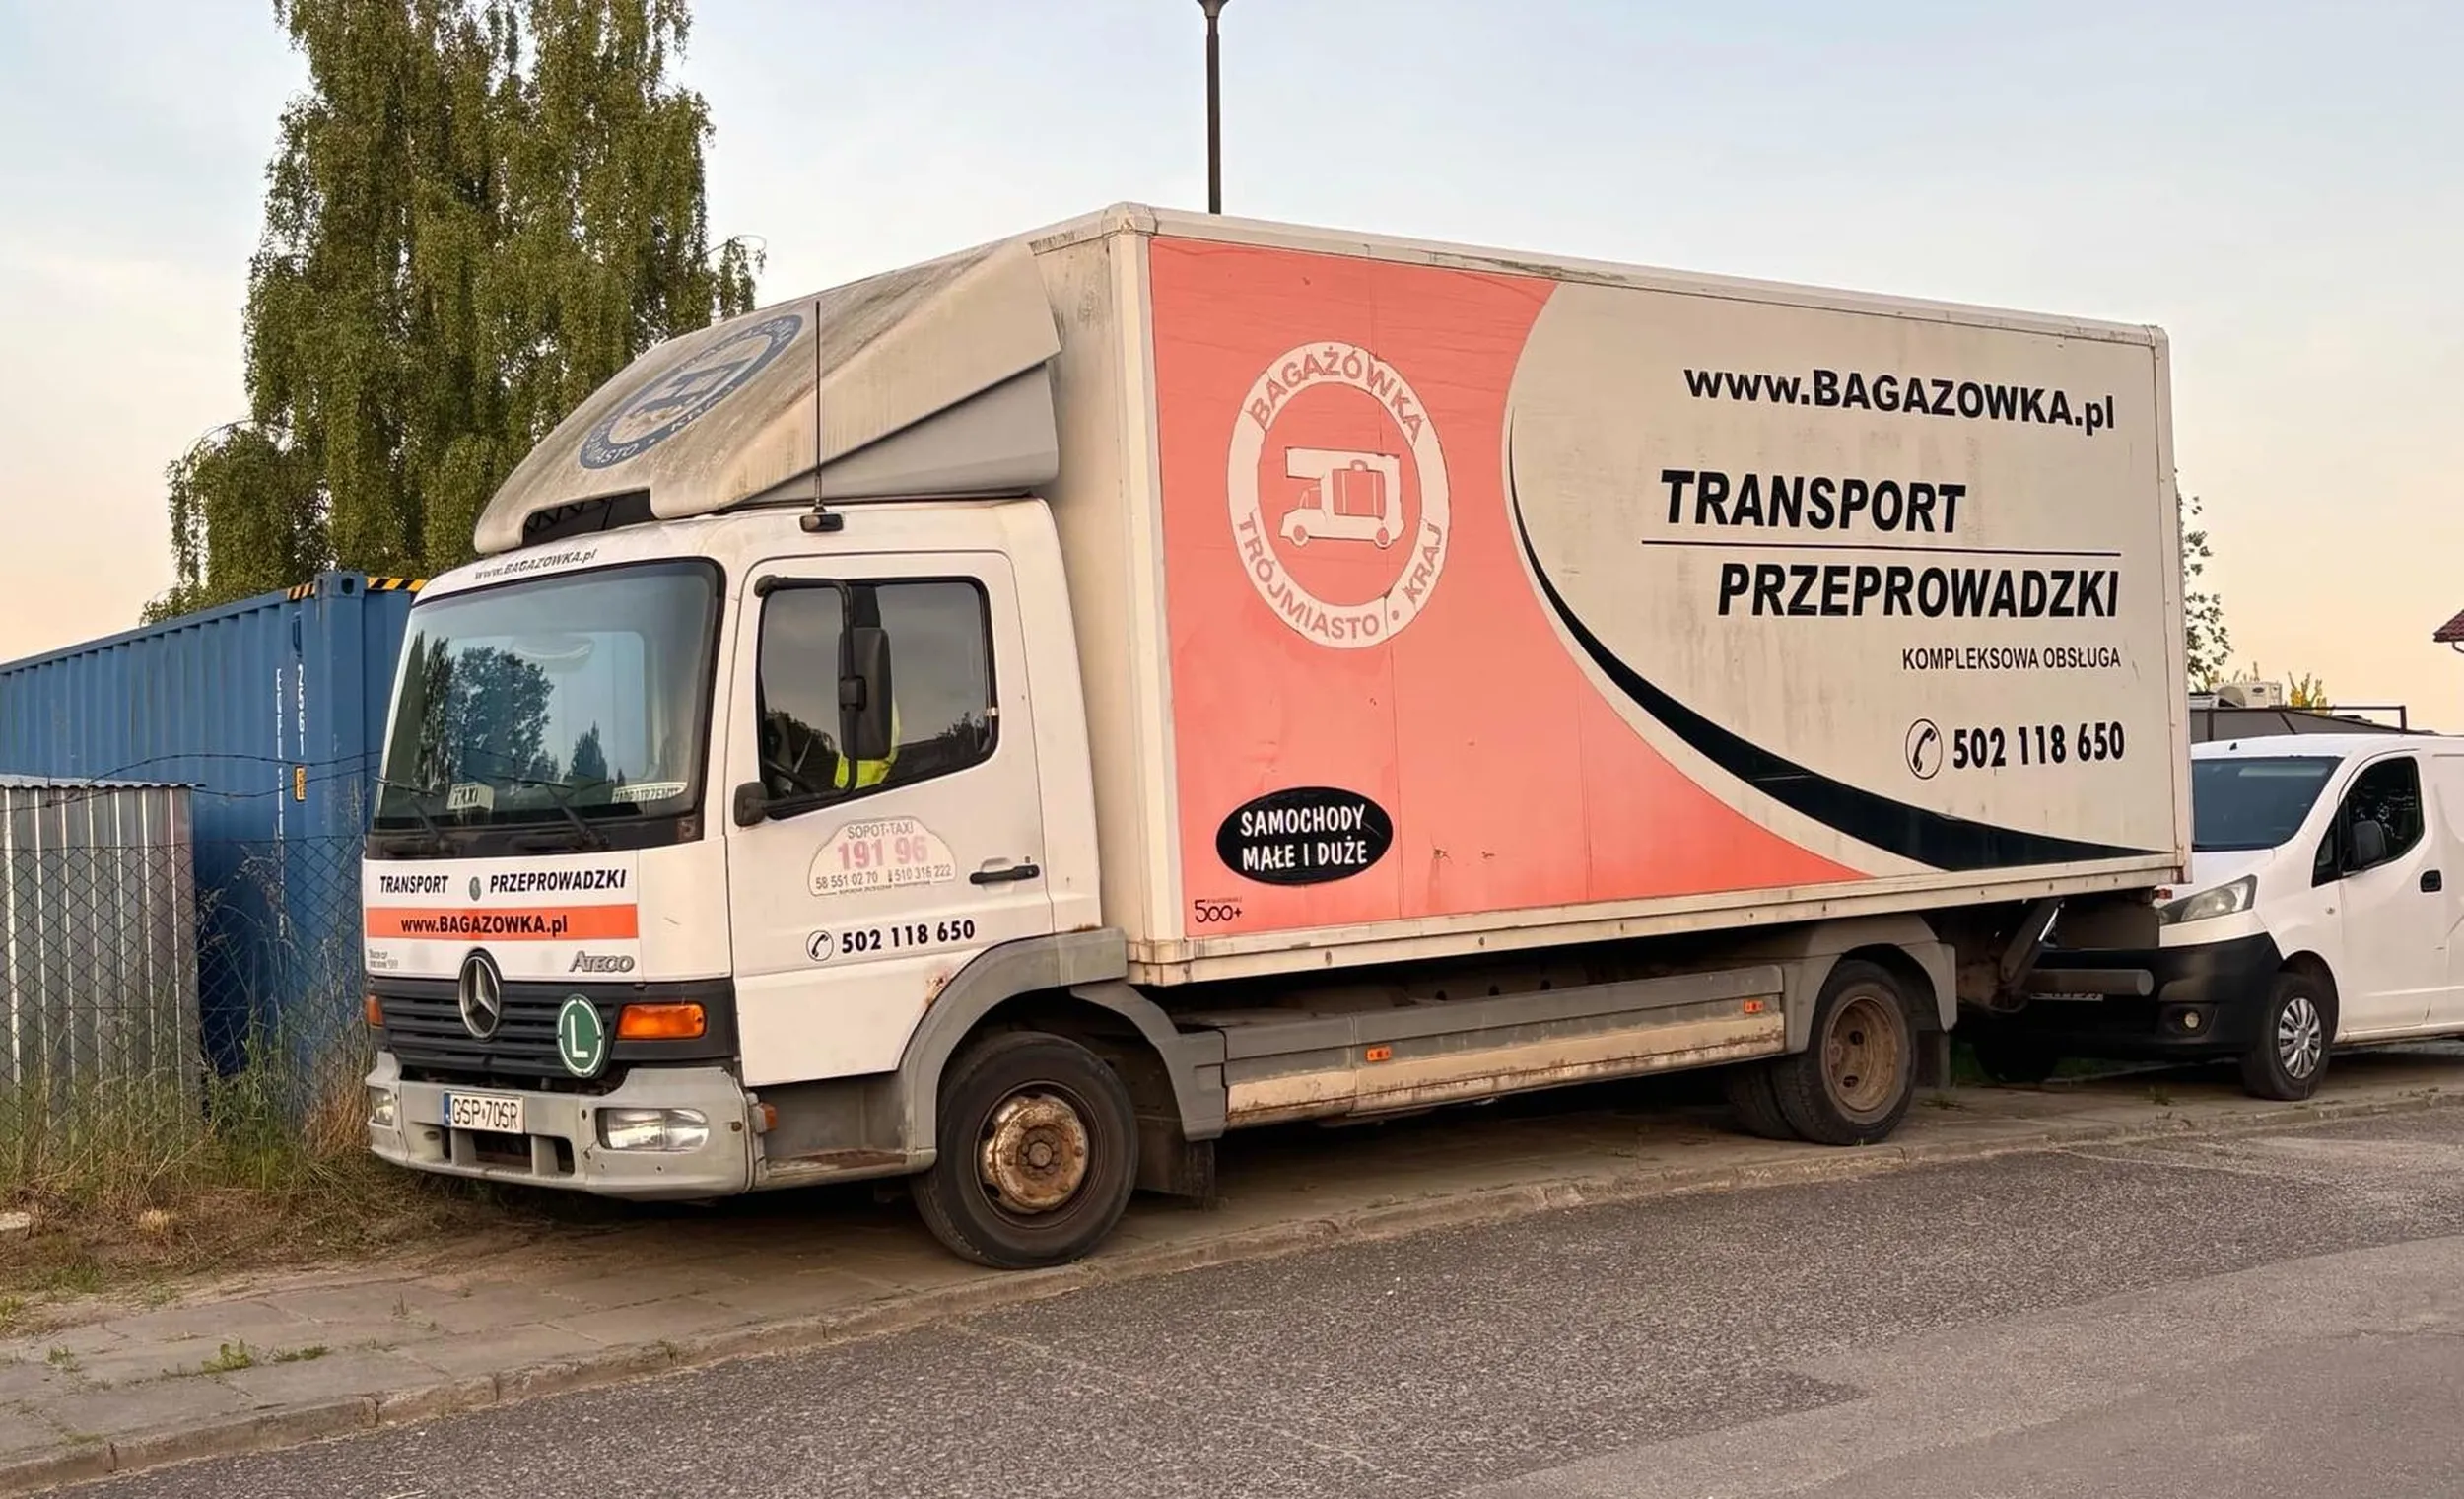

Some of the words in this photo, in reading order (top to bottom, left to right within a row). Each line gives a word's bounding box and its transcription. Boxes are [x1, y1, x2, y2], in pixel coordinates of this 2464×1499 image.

[1246, 345, 1425, 446] BAGAŻÓWKA
[1683, 368, 2115, 436] www.BAGAZOWKA.pl
[1661, 469, 1966, 533] TRANSPORT
[475, 548, 597, 579] www.BAGAZOWKA.pl
[1239, 510, 1380, 640] TRÓJMIASTO
[1403, 520, 1442, 606] KRAJ
[1718, 563, 2119, 618] PRZEPROWADZKI
[1902, 647, 2039, 670] KOMPLEKSOWA
[2043, 647, 2122, 669] OBSŁUGA
[1953, 727, 2006, 768] 502
[2018, 724, 2067, 765] 118
[2077, 721, 2125, 761] 650
[1240, 804, 1366, 837] SAMOCHODY
[838, 839, 884, 871] 191
[895, 836, 928, 865] 96
[1242, 844, 1296, 871] MAŁE
[1304, 843, 1310, 866] I
[1318, 836, 1368, 866] DUŻE
[380, 875, 449, 894] TRANSPORT
[490, 869, 627, 894] PRZEPROWADZKI
[815, 876, 828, 889] 58
[401, 915, 568, 937] www.BAGAZOWKA.pl
[1195, 899, 1242, 923] 500+
[841, 929, 881, 953] 502
[891, 924, 928, 947] 118
[938, 920, 976, 942] 650
[570, 1014, 588, 1058] L
